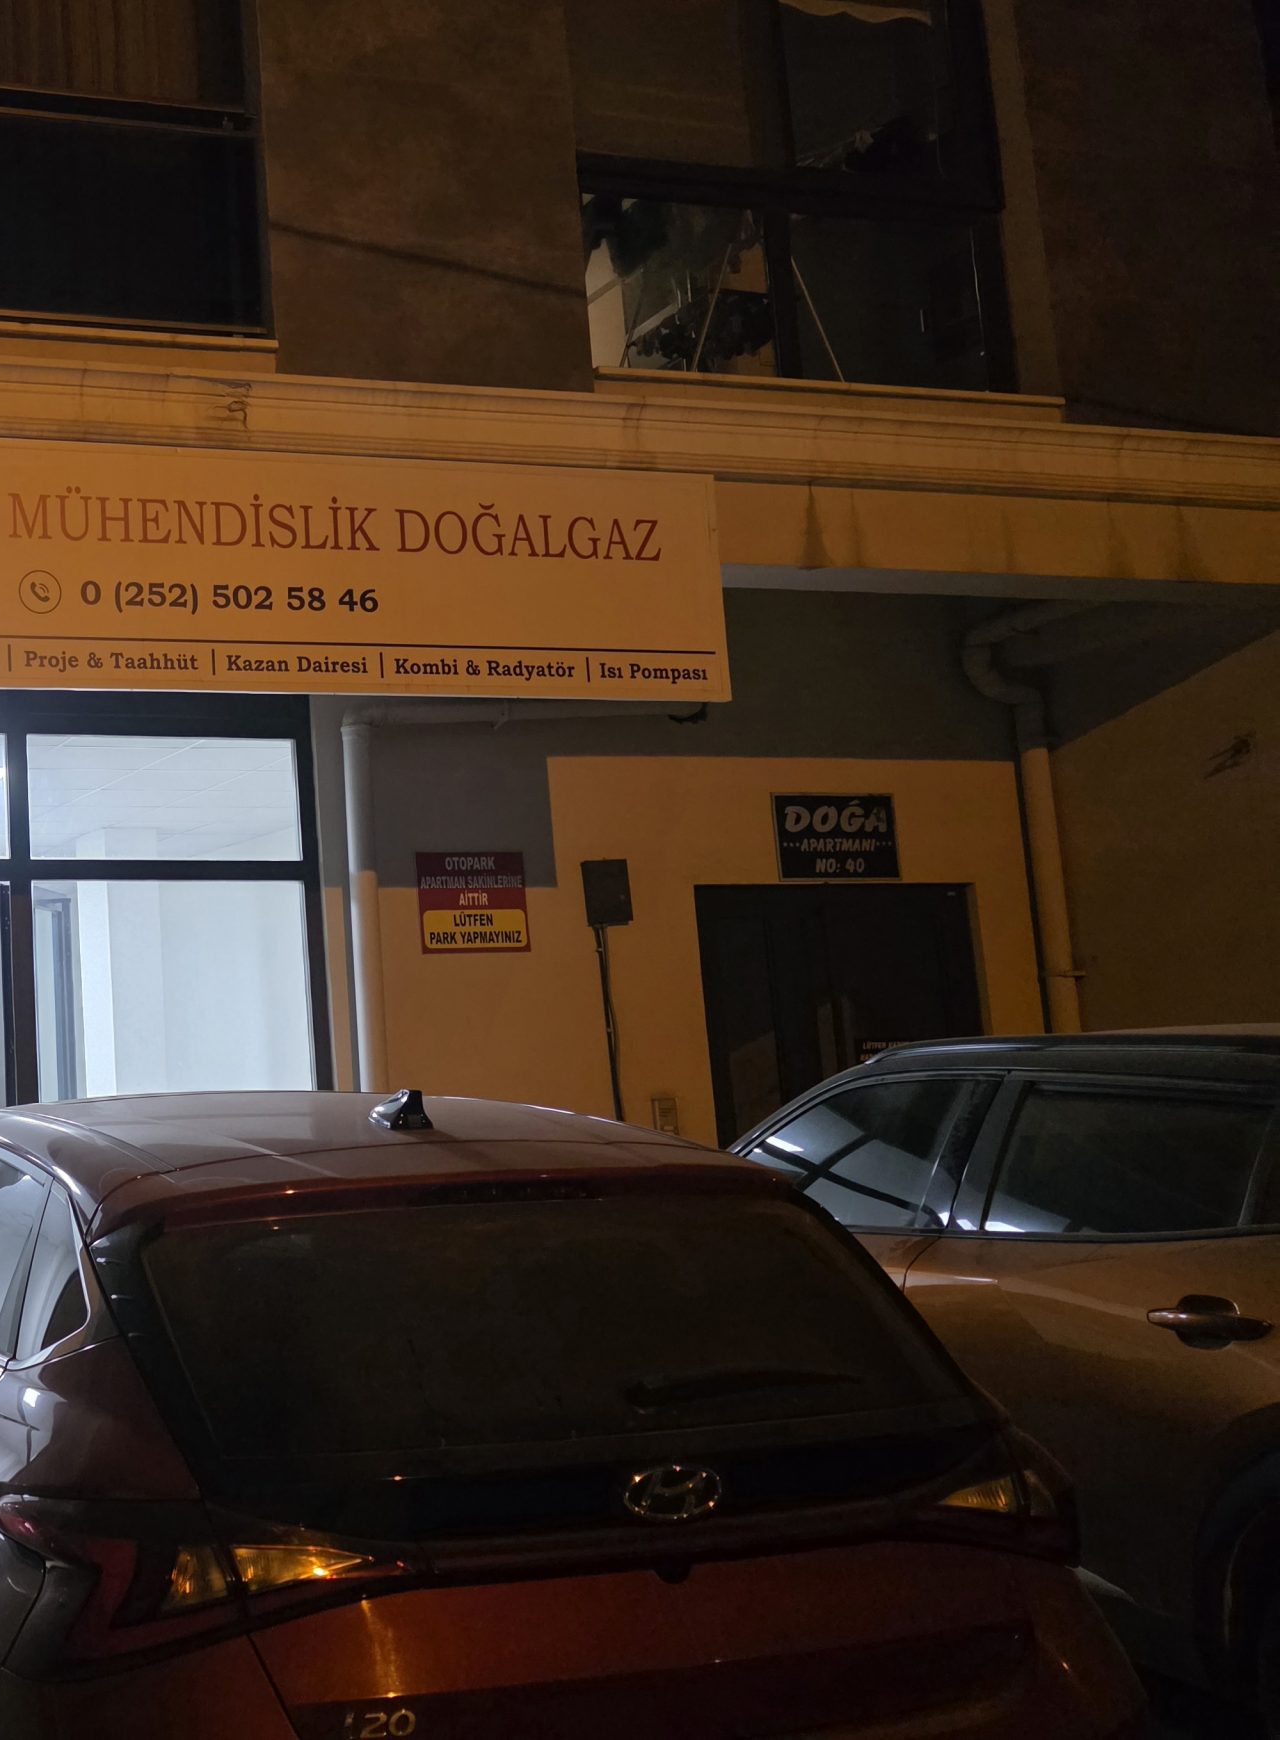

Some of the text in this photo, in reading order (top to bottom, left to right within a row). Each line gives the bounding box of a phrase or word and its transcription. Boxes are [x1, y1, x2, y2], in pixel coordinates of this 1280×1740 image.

[7, 485, 381, 552] MÜHENDİSLİK
[394, 502, 662, 562] DOĞALGAZ
[80, 580, 380, 615] 0 (252) 502 58 46
[24, 650, 199, 673] Proje & Taahhüt
[226, 654, 369, 674] Kazan Dairesi
[394, 658, 576, 682] Kombi & Radyatör
[599, 662, 709, 684] Isı Pompası
[784, 799, 888, 833] DOĞA
[800, 838, 876, 852] APARTMANI
[445, 857, 495, 870] OTOPARK
[815, 858, 865, 873] NO: 40
[420, 872, 523, 889] APARTMAN SAKİNLERİNE
[458, 890, 489, 906] AİTTİR
[453, 911, 494, 927] LÜTFEN
[429, 930, 522, 945] PARK YAPMAYINIZ
